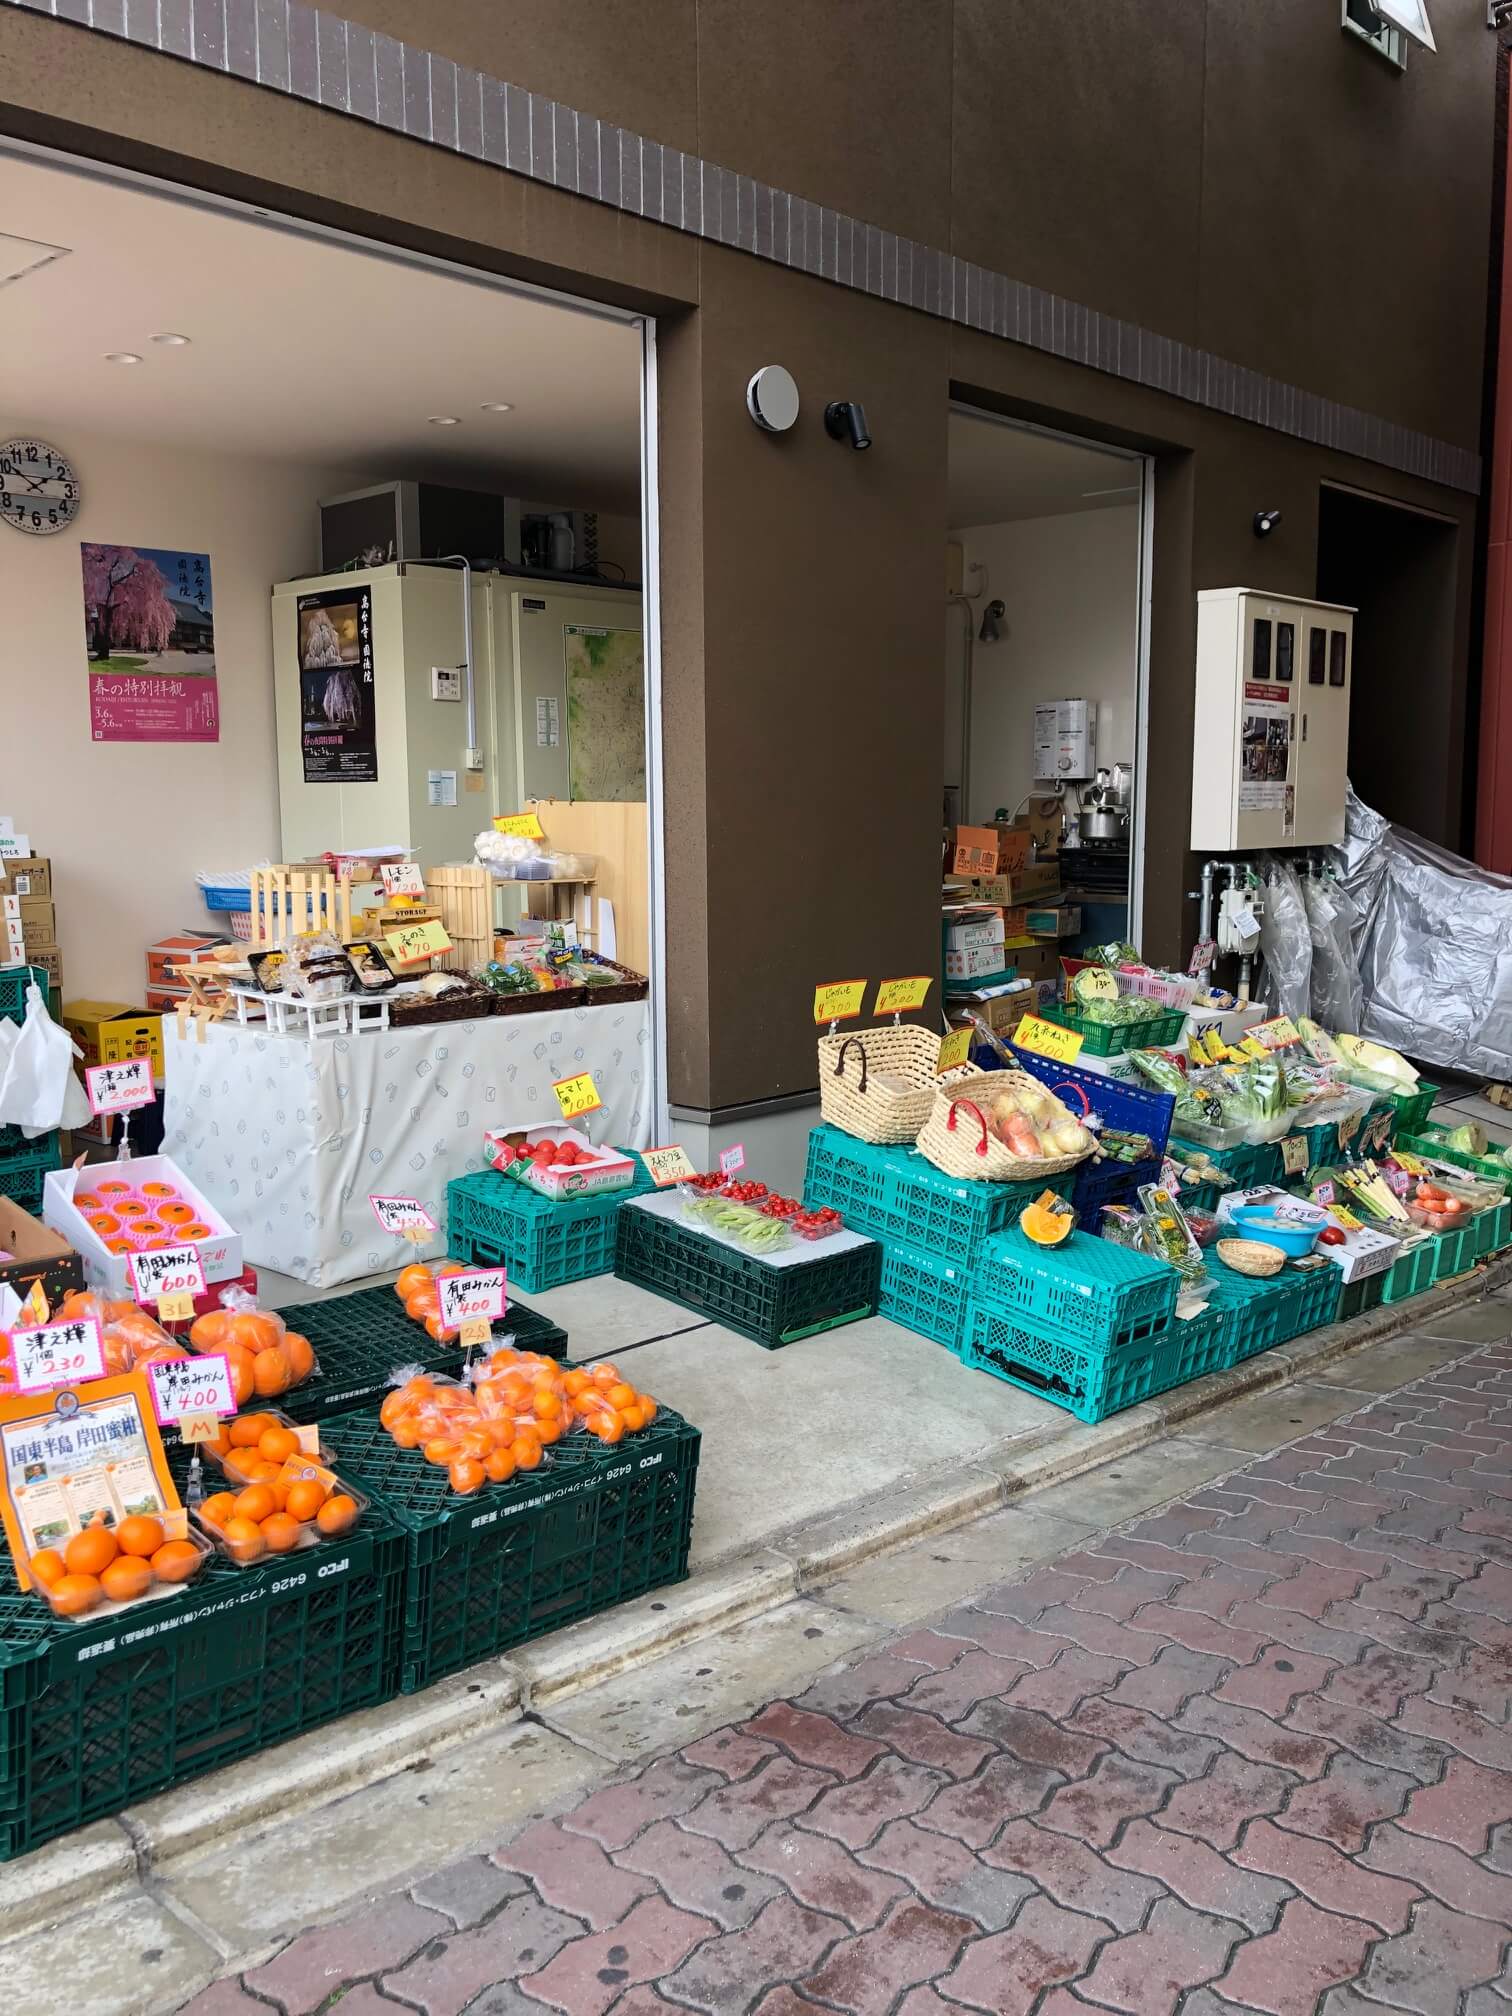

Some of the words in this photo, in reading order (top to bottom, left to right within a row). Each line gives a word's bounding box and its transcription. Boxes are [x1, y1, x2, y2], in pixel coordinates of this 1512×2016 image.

[11, 447, 22, 465] 11
[25, 446, 39, 462] 12
[45, 453, 51, 468] 1
[0, 458, 11, 474] 10
[57, 466, 66, 481] 2
[2, 491, 12, 507] 8
[64, 483, 73, 499] 3
[16, 505, 25, 520] 7
[59, 499, 68, 514] 4
[32, 510, 41, 527] 6
[49, 508, 58, 524] 5
[94, 676, 187, 697] 春の特別拝観
[387, 866, 414, 877] レモン
[395, 908, 427, 916] STORAGE
[400, 927, 426, 943] えのき
[99, 1063, 141, 1085] 津之輝
[556, 1080, 584, 1099] トマト
[136, 1251, 200, 1273] 有田みかん
[447, 1276, 505, 1298] 有田みかん
[164, 1301, 188, 1316] 3L
[25, 1323, 88, 1352] 津之輝
[154, 1360, 190, 1378] 国東半島
[168, 1371, 225, 1389] 岸田みかん
[190, 1421, 212, 1437] M
[11, 1434, 74, 1467] 国東半島
[77, 1416, 138, 1449] 岸田蜜柑
[639, 1453, 663, 1469] IFCO
[606, 1463, 632, 1481] 6426
[317, 1557, 350, 1578] IFCO
[271, 1572, 307, 1595] 6426
